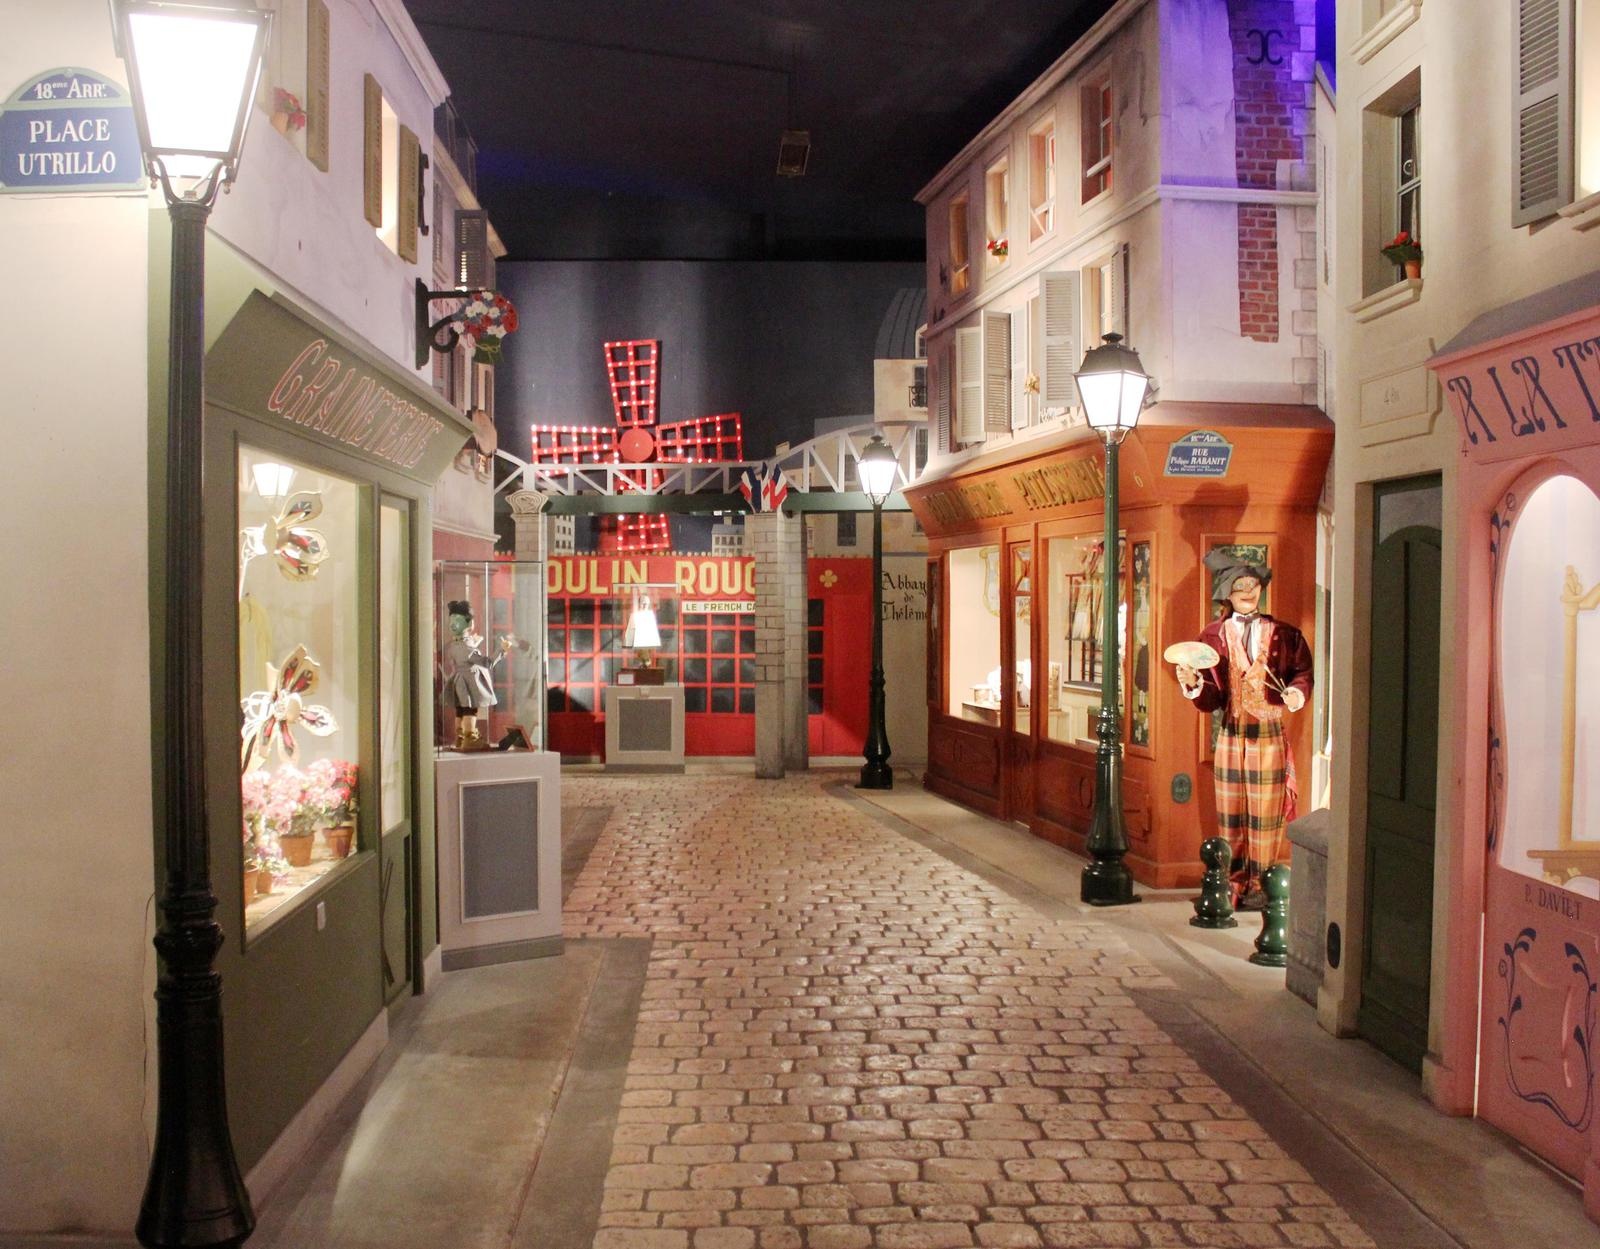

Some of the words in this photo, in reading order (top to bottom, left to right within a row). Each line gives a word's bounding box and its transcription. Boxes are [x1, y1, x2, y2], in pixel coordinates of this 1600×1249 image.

[29, 119, 111, 143] PLACE
[18, 151, 116, 176] UTRILLO
[267, 339, 445, 469] GRAINETERIE
[1192, 448, 1208, 456] RUE
[881, 571, 927, 597] Abbay
[686, 603, 697, 611] LE
[704, 602, 741, 611] FRENCH
[904, 592, 914, 602] de
